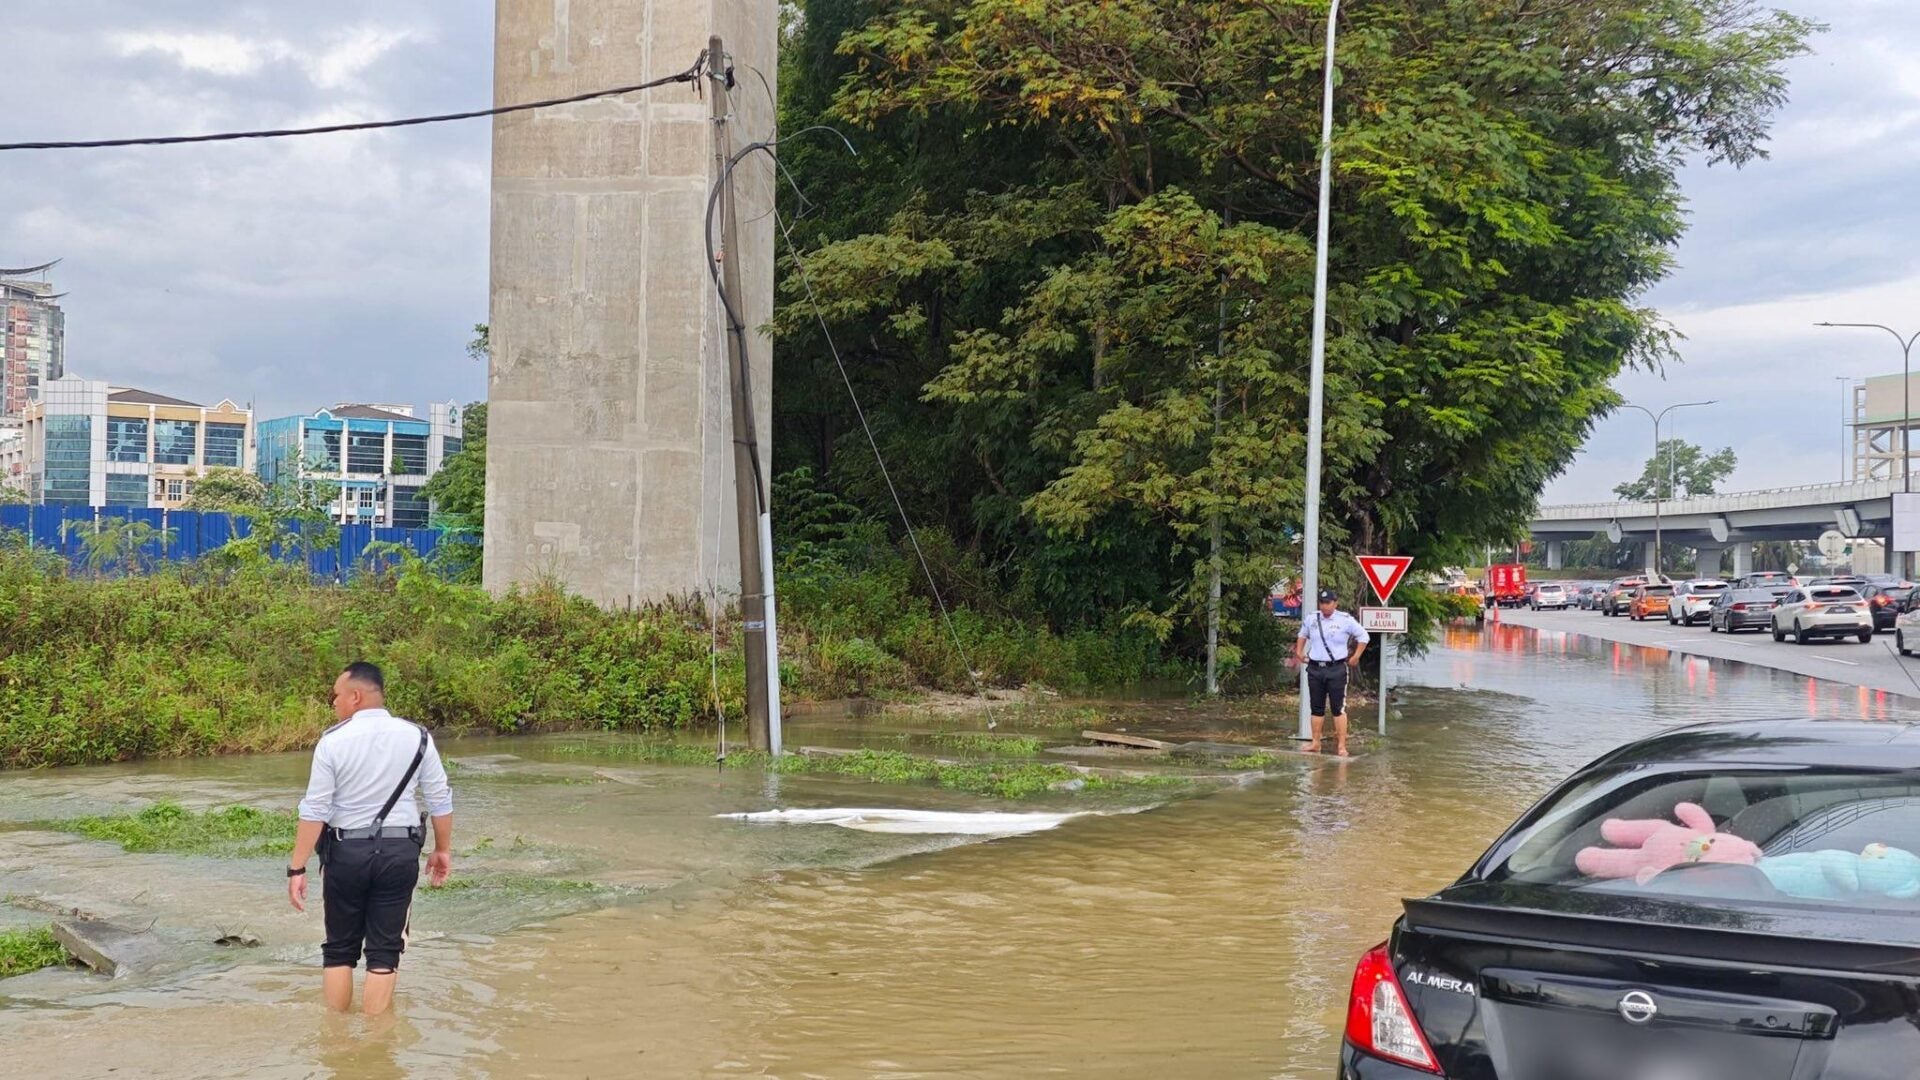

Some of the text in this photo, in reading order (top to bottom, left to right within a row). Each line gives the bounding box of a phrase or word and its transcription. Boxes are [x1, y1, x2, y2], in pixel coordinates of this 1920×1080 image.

[1375, 612, 1392, 620] BERI
[1369, 620, 1397, 628] LALUAN
[1406, 971, 1476, 996] ALMERA
